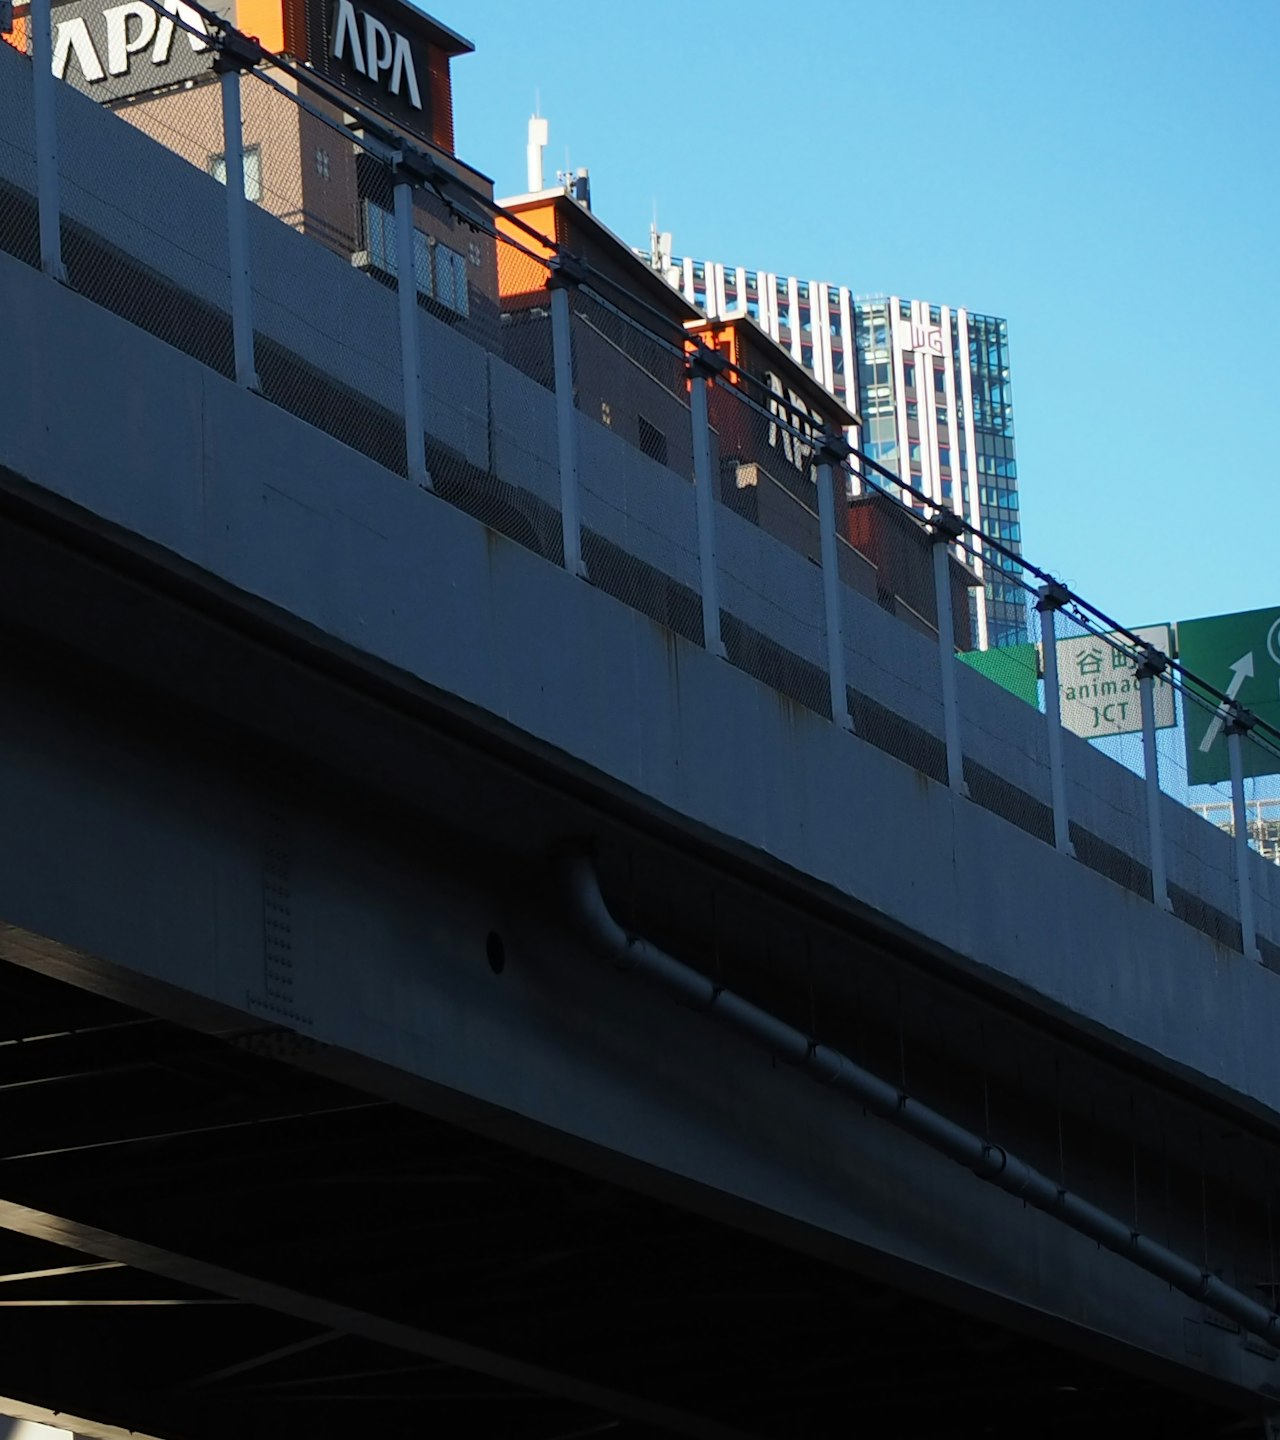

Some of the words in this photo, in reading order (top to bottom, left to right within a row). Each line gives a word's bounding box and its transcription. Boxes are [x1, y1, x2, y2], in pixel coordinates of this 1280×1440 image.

[51, 0, 210, 83] APA
[333, 0, 423, 111] APA
[1092, 702, 1130, 728] JCT
